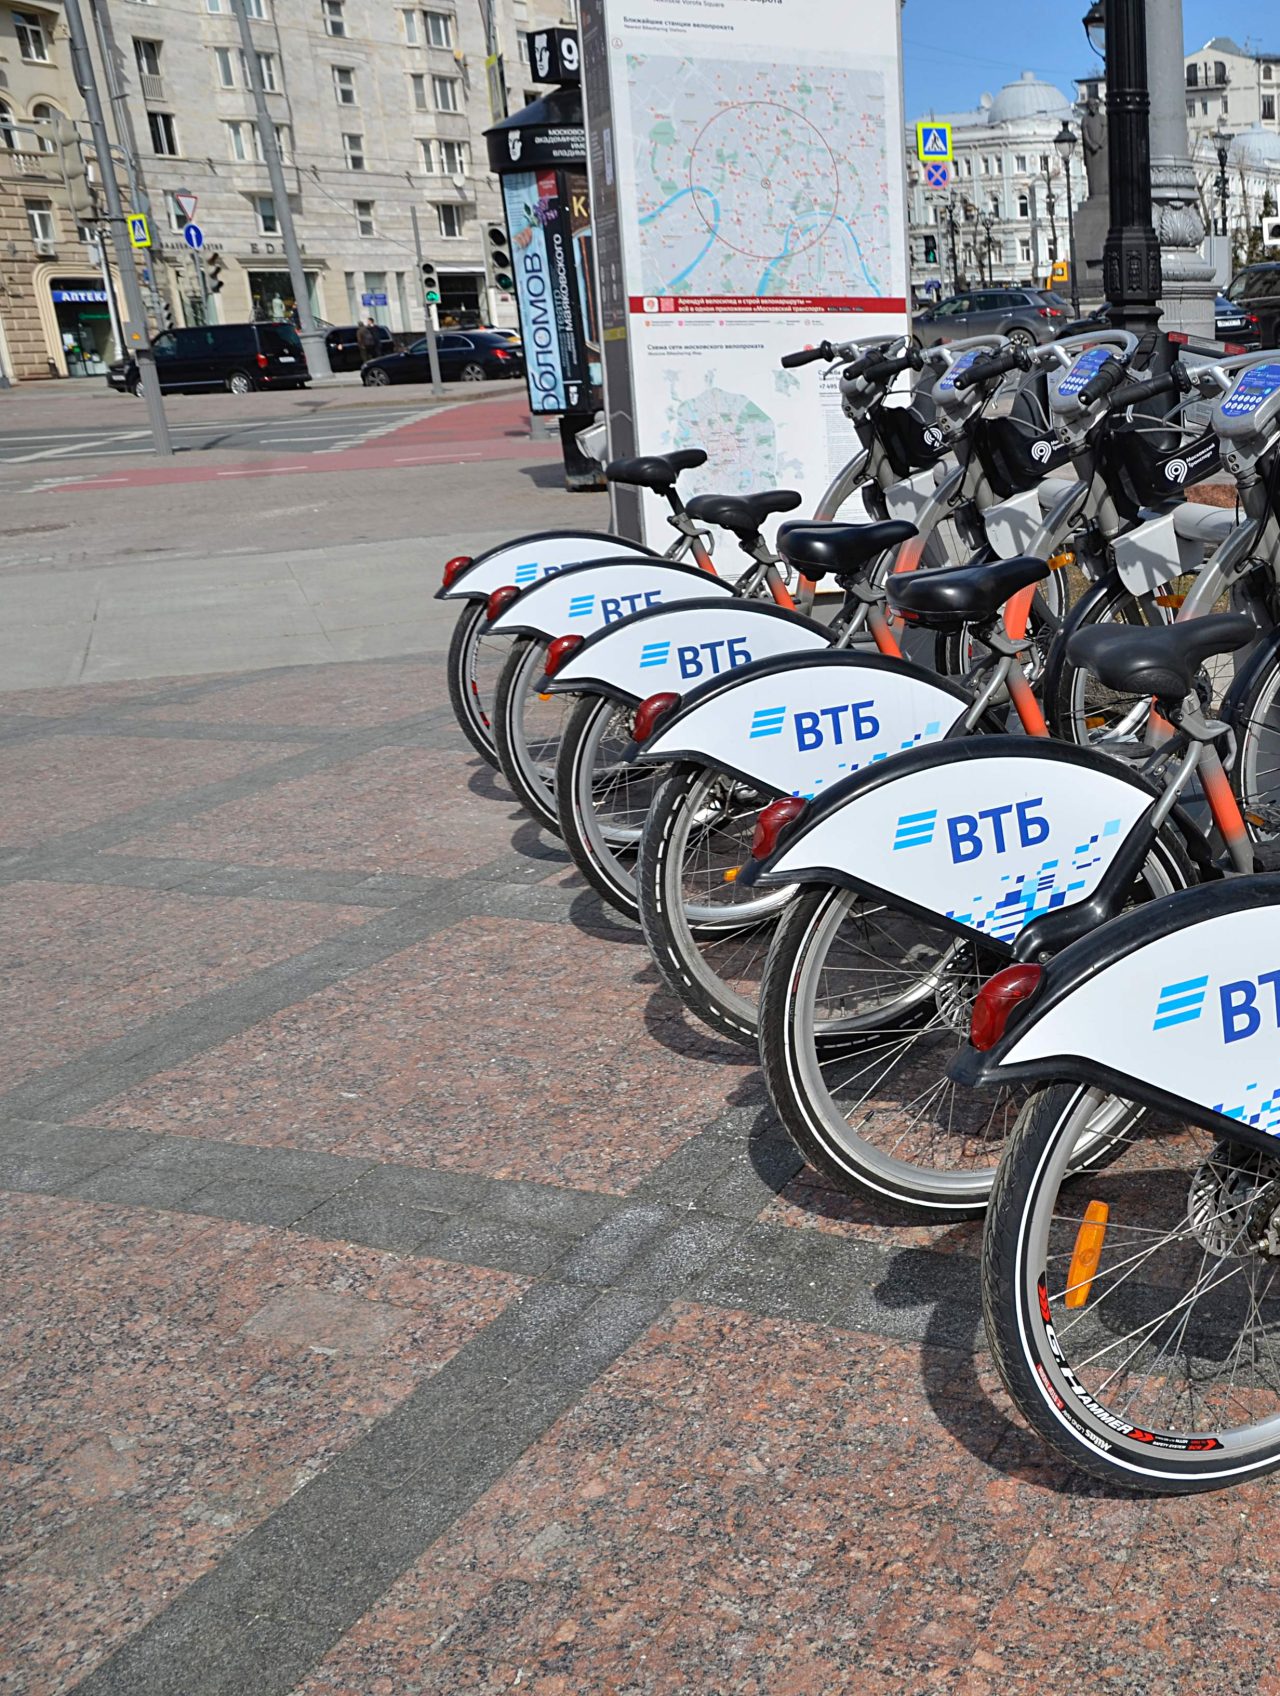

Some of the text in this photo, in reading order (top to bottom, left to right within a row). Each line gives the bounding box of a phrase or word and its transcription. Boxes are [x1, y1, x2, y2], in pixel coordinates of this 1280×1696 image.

[623, 16, 734, 30] Ближайшие станции велопроката
[561, 37, 579, 71] 9
[1186, 443, 1216, 464] Московский
[1188, 451, 1213, 468] Транспорт
[677, 637, 752, 680] ВТБ
[794, 700, 880, 752] ВТБ
[947, 797, 1050, 864] ВТБ
